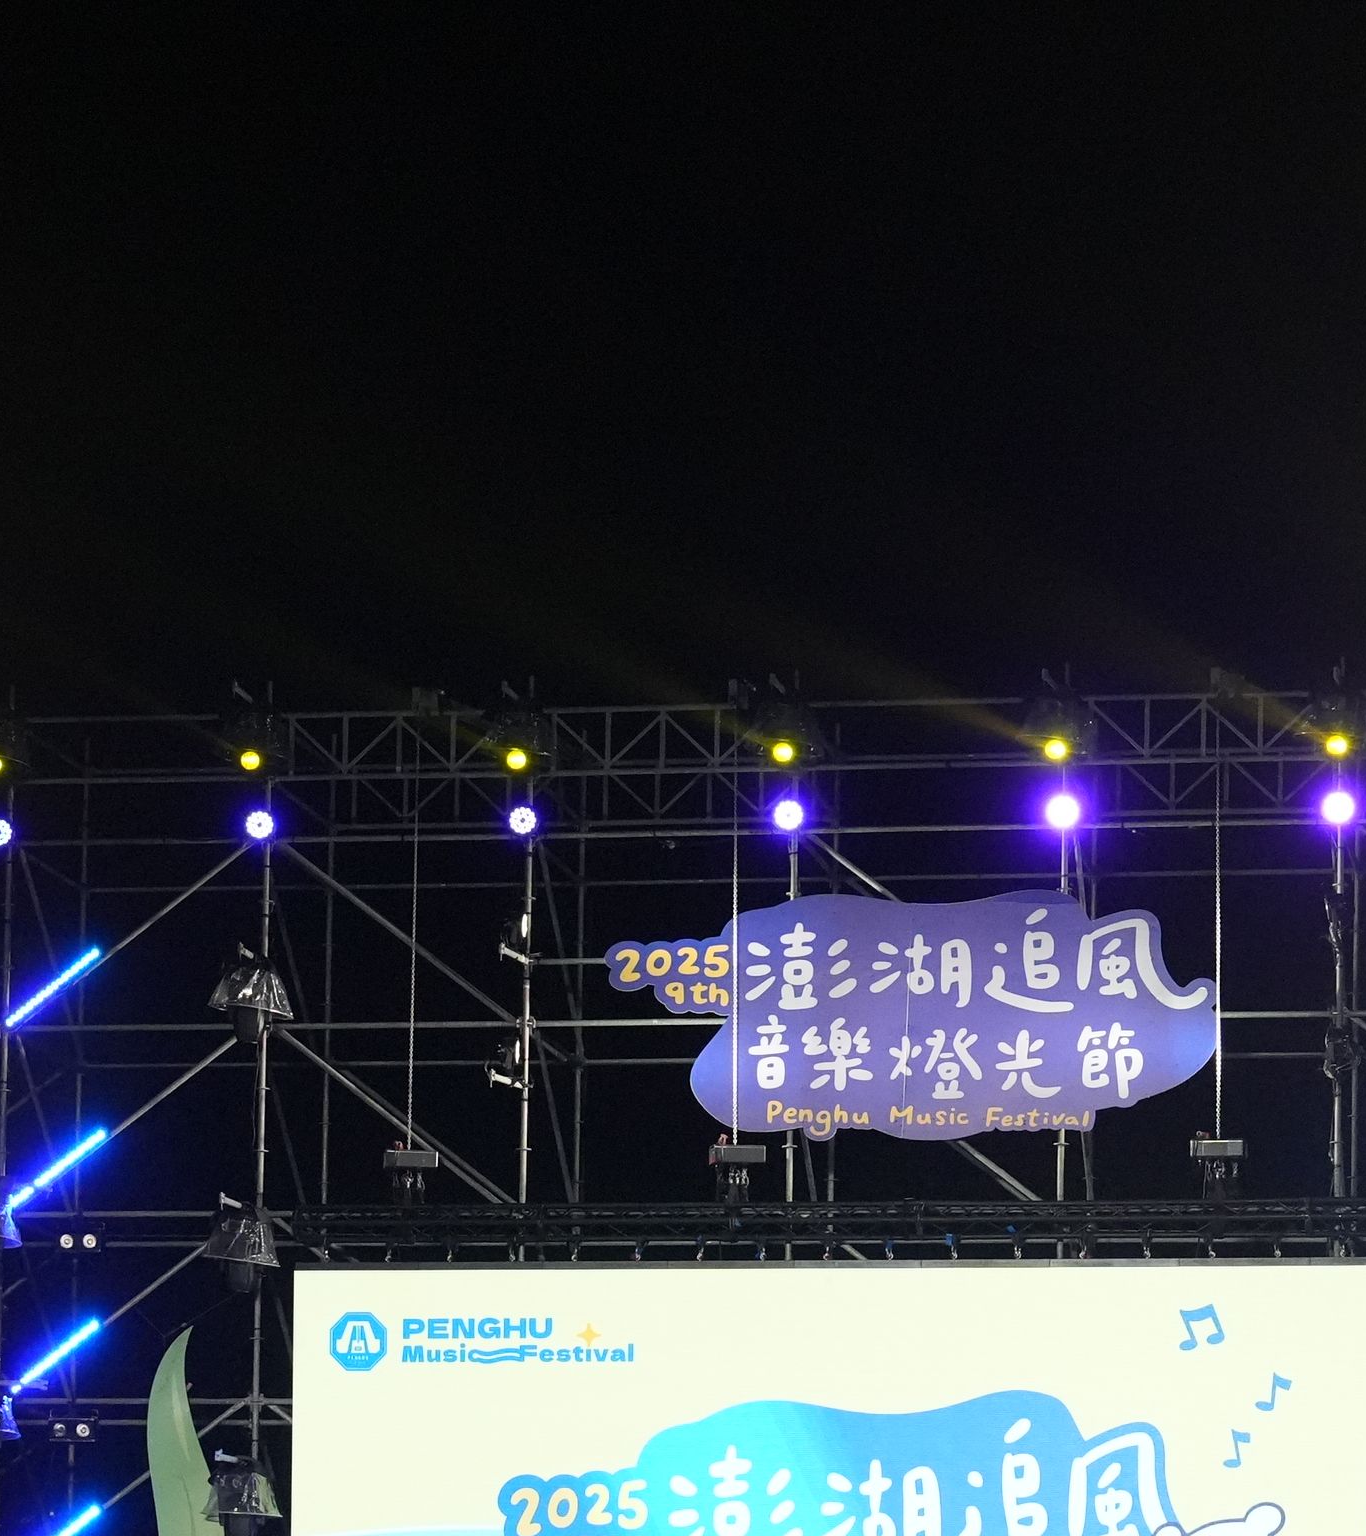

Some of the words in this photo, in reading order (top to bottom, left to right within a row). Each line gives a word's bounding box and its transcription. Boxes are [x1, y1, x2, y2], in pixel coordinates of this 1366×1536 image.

[615, 944, 729, 982] 2025
[744, 908, 1209, 1012] 澎湖追風
[664, 981, 729, 1006] 9th
[748, 1015, 1145, 1100] 音樂燈光節
[766, 1100, 870, 1135] Penghu
[889, 1106, 969, 1127] Music
[985, 1107, 1092, 1130] Festival
[402, 1318, 553, 1340] PENGHU
[401, 1343, 485, 1363] Music
[519, 1343, 635, 1363] Festival
